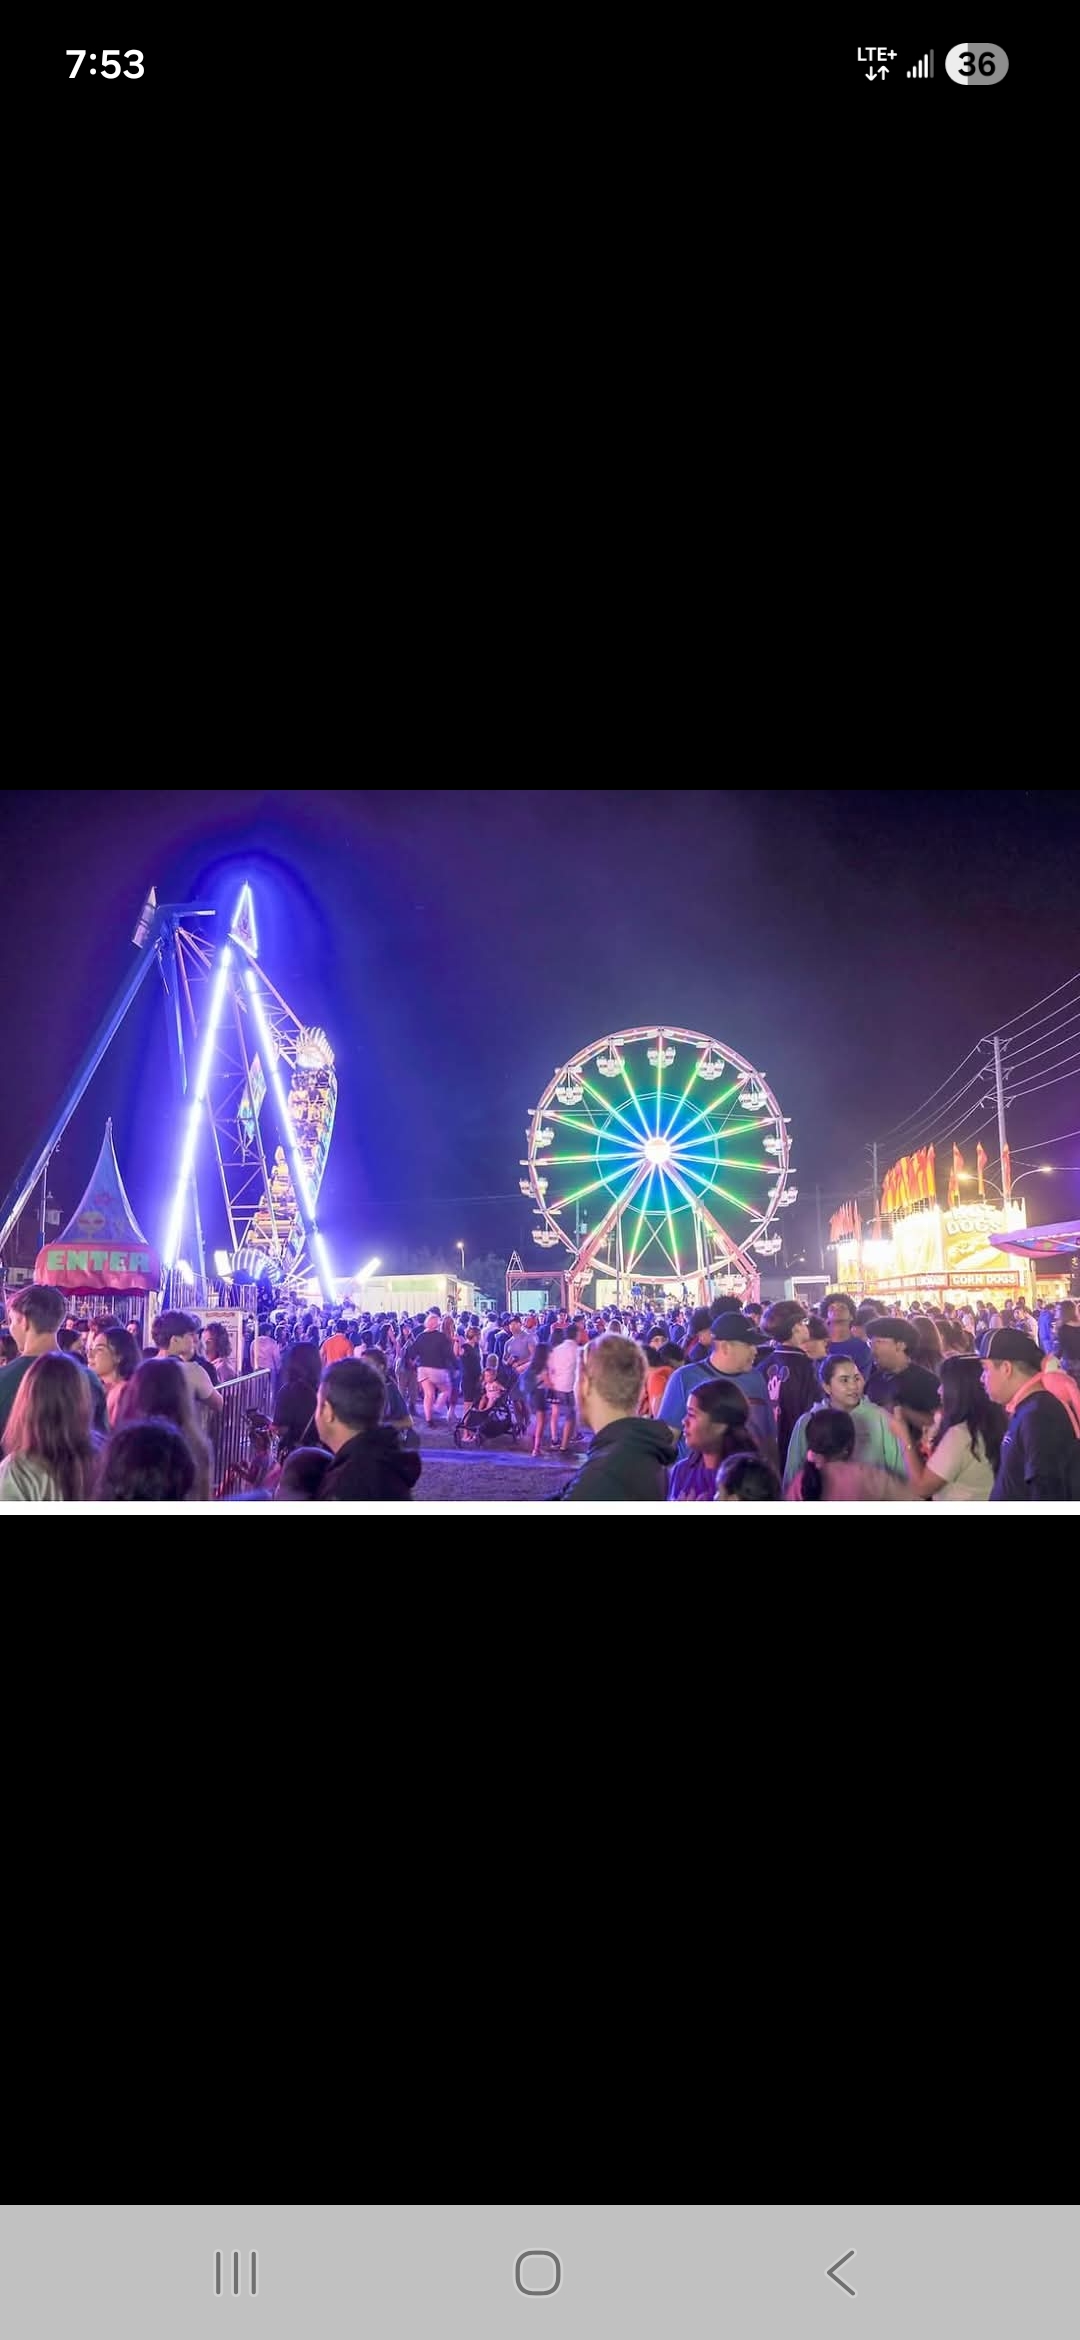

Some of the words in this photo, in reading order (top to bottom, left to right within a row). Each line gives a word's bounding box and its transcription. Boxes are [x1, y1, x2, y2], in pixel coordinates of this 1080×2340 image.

[47, 1251, 150, 1272] ENTER
[952, 1276, 982, 1285] CORN
[987, 1275, 1016, 1284] DOGS
